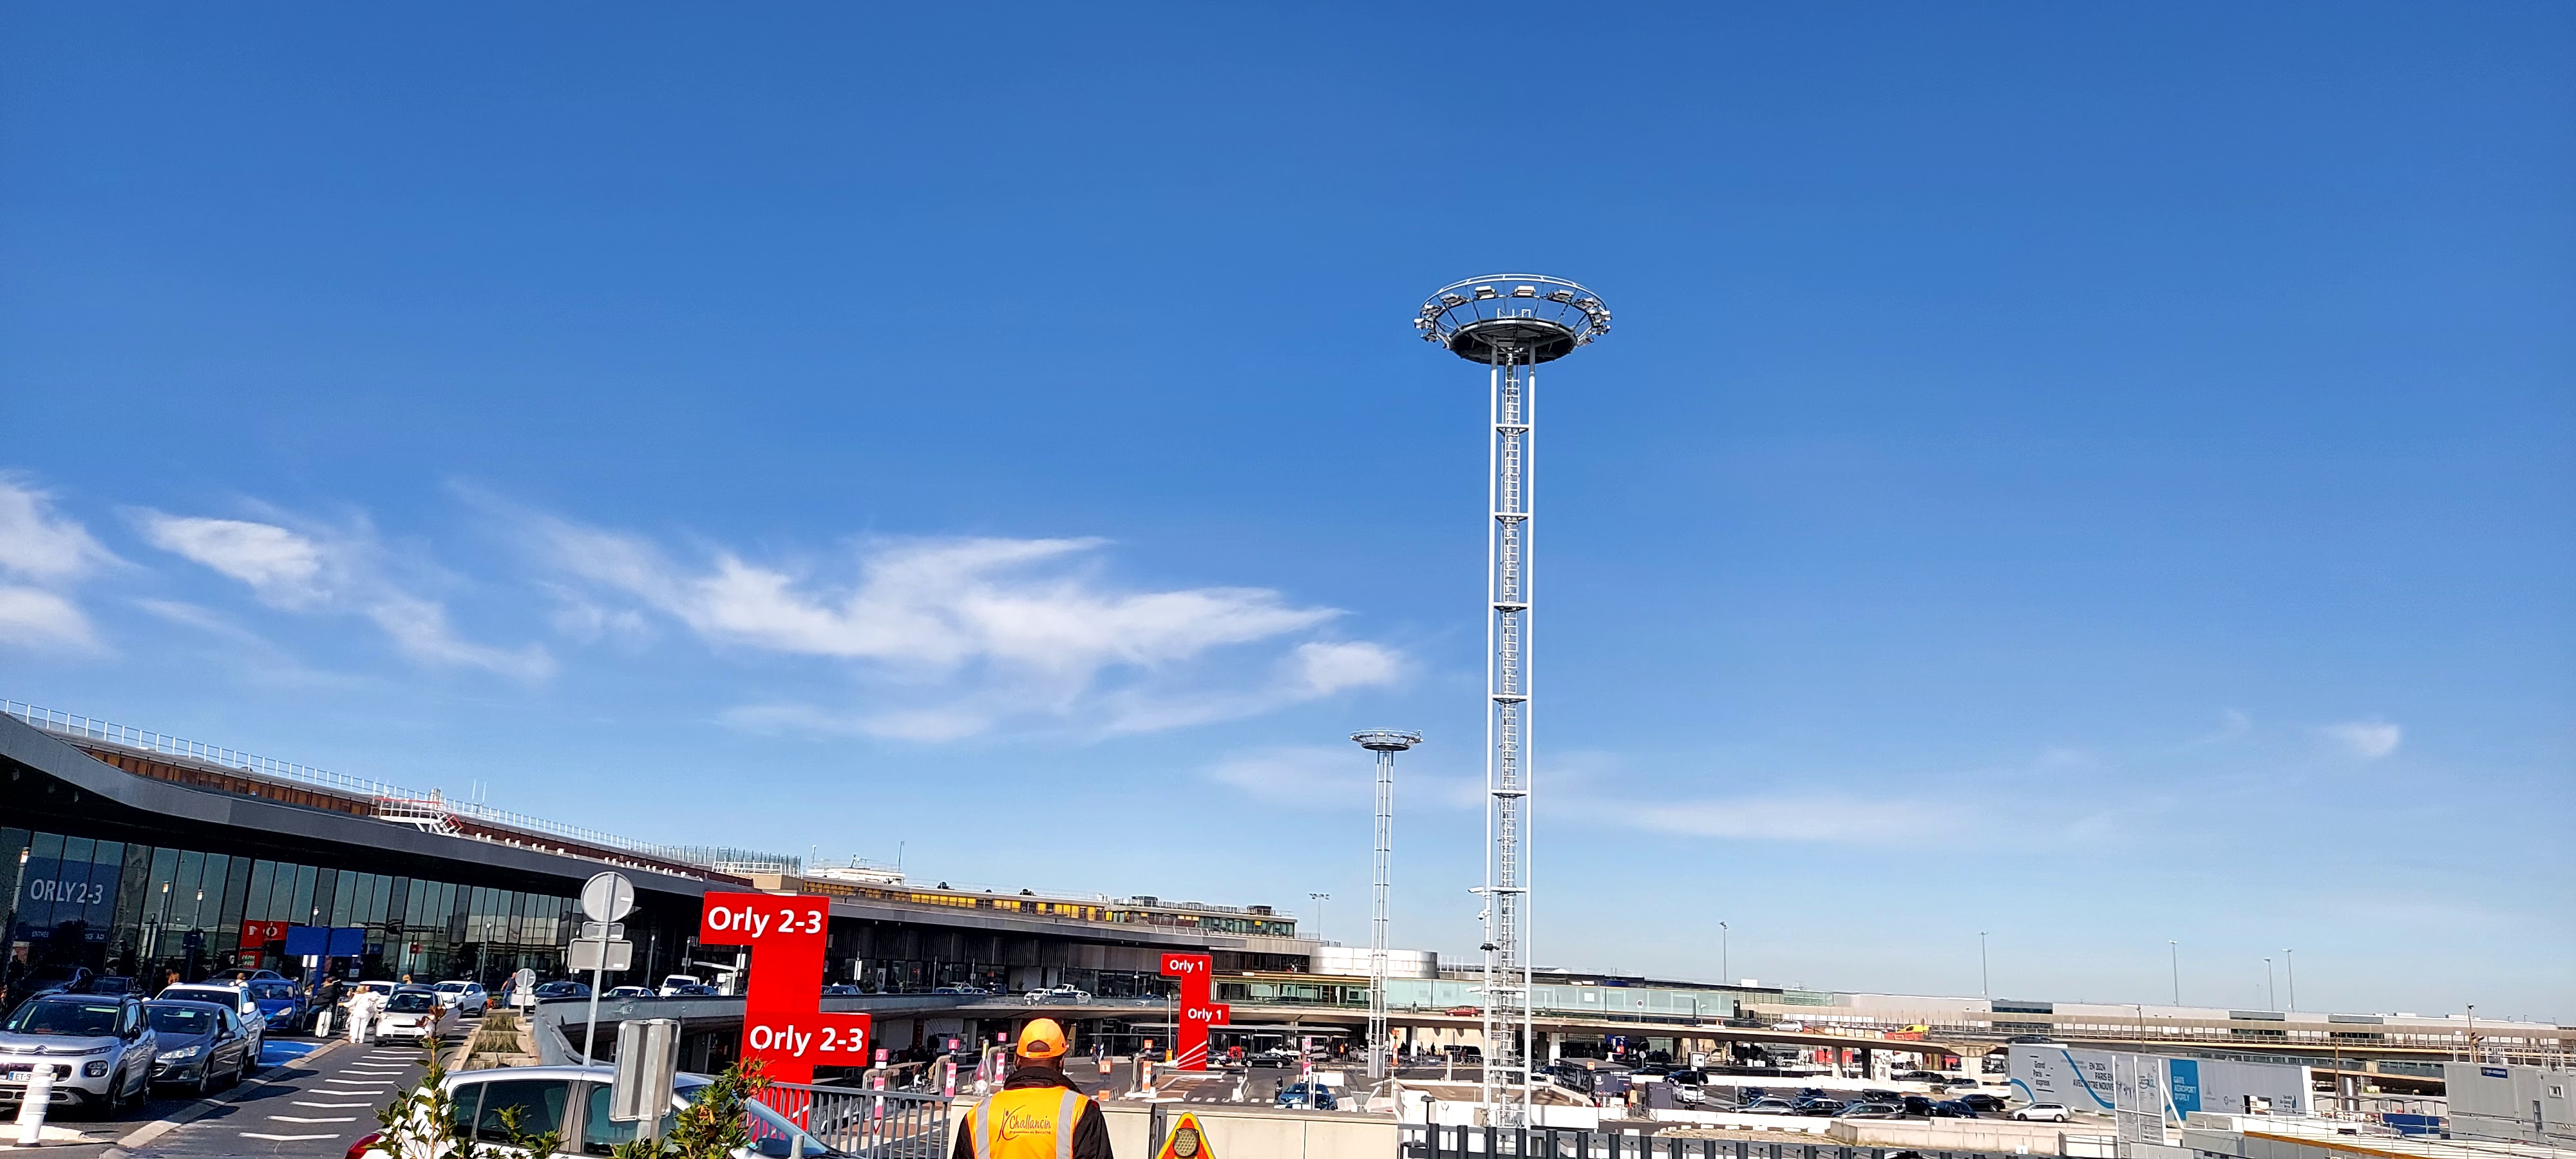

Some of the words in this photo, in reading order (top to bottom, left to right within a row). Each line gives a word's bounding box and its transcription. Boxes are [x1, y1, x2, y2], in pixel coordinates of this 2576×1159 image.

[30, 879, 77, 903] ORLY
[77, 883, 104, 904] 2-3
[708, 906, 770, 938] Orly
[778, 909, 822, 934] 2-3
[1170, 959, 1194, 973] Orly
[1198, 961, 1203, 971] 1
[1188, 1008, 1212, 1022] Orly
[1217, 1009, 1222, 1020] 1
[750, 1024, 811, 1057] Orly
[819, 1027, 863, 1052] 2-3
[1009, 1115, 1051, 1129] Challancin
